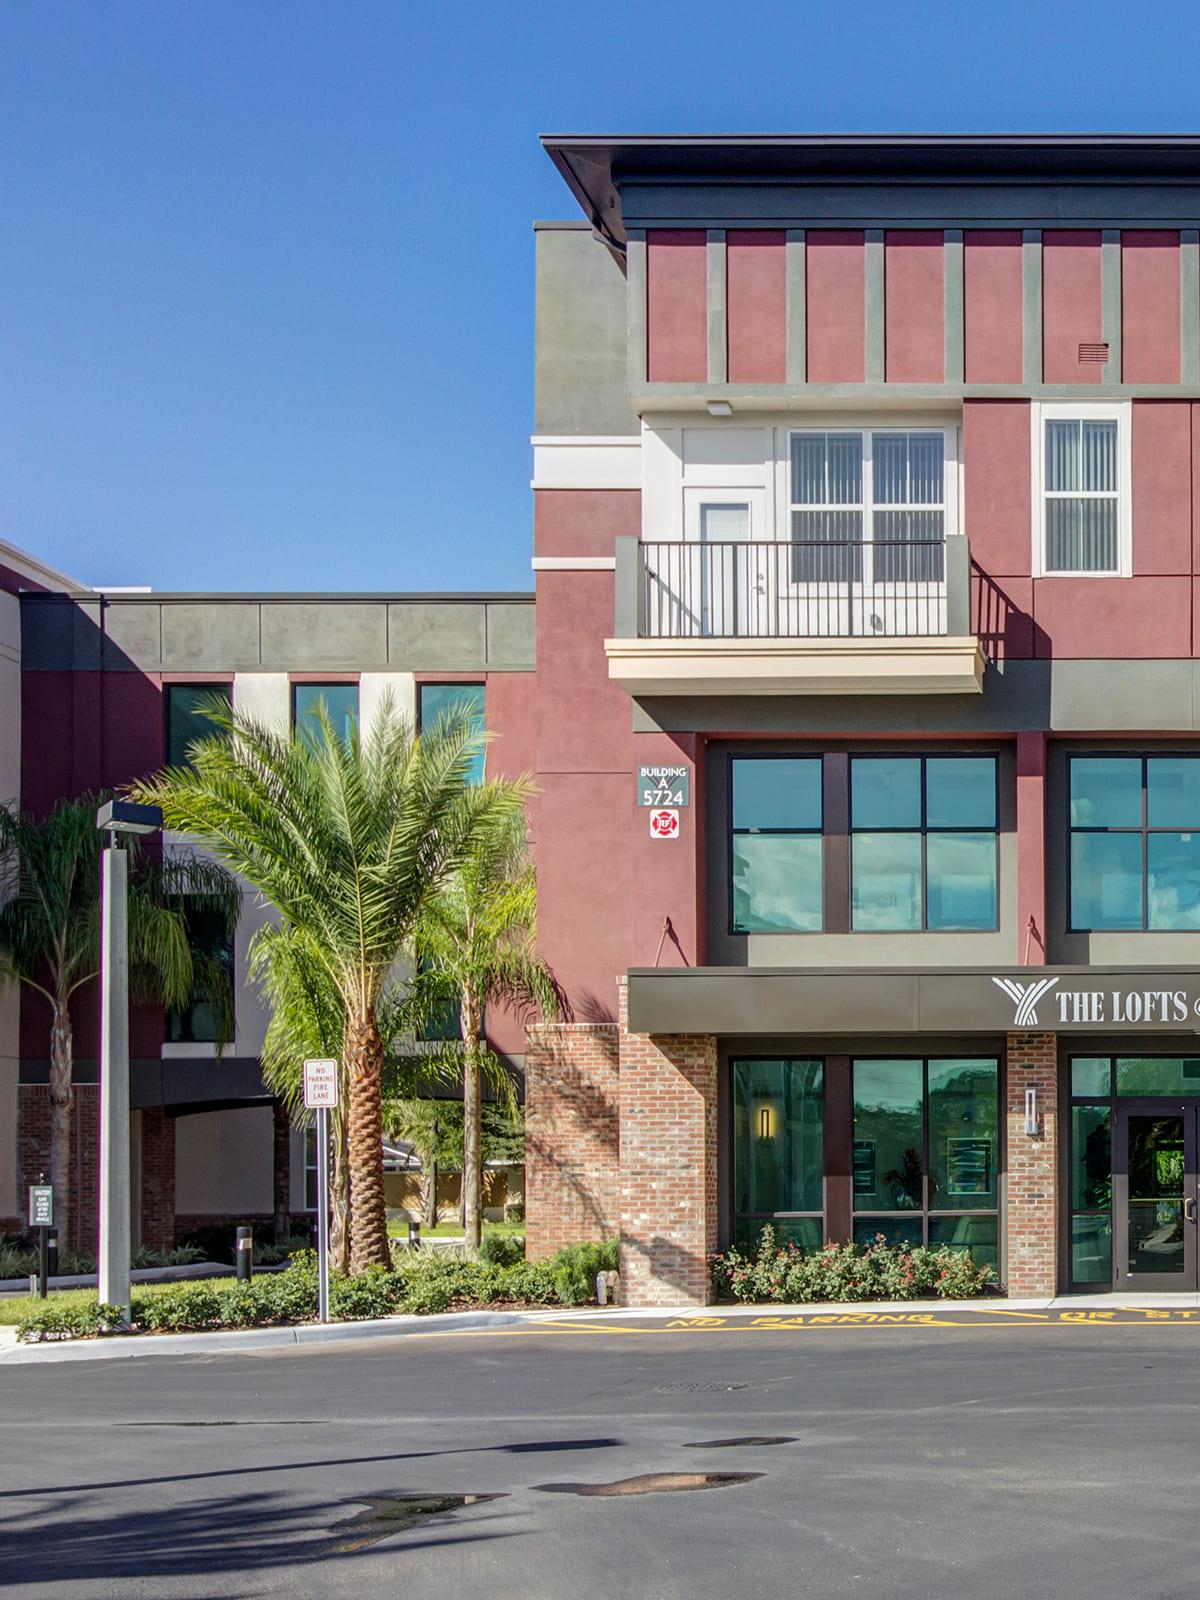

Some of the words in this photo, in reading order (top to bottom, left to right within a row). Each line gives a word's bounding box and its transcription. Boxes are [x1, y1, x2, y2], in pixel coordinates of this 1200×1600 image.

[640, 767, 687, 777] BUILDING
[658, 777, 668, 789] A
[643, 790, 684, 806] 5724
[659, 819, 671, 828] RF
[1055, 991, 1105, 1023] THE
[1111, 990, 1190, 1023] LOFTS
[308, 1075, 334, 1083] PARKING
[665, 1316, 727, 1327] NO
[750, 1312, 934, 1325] PARKING
[1058, 1311, 1117, 1319] OR
